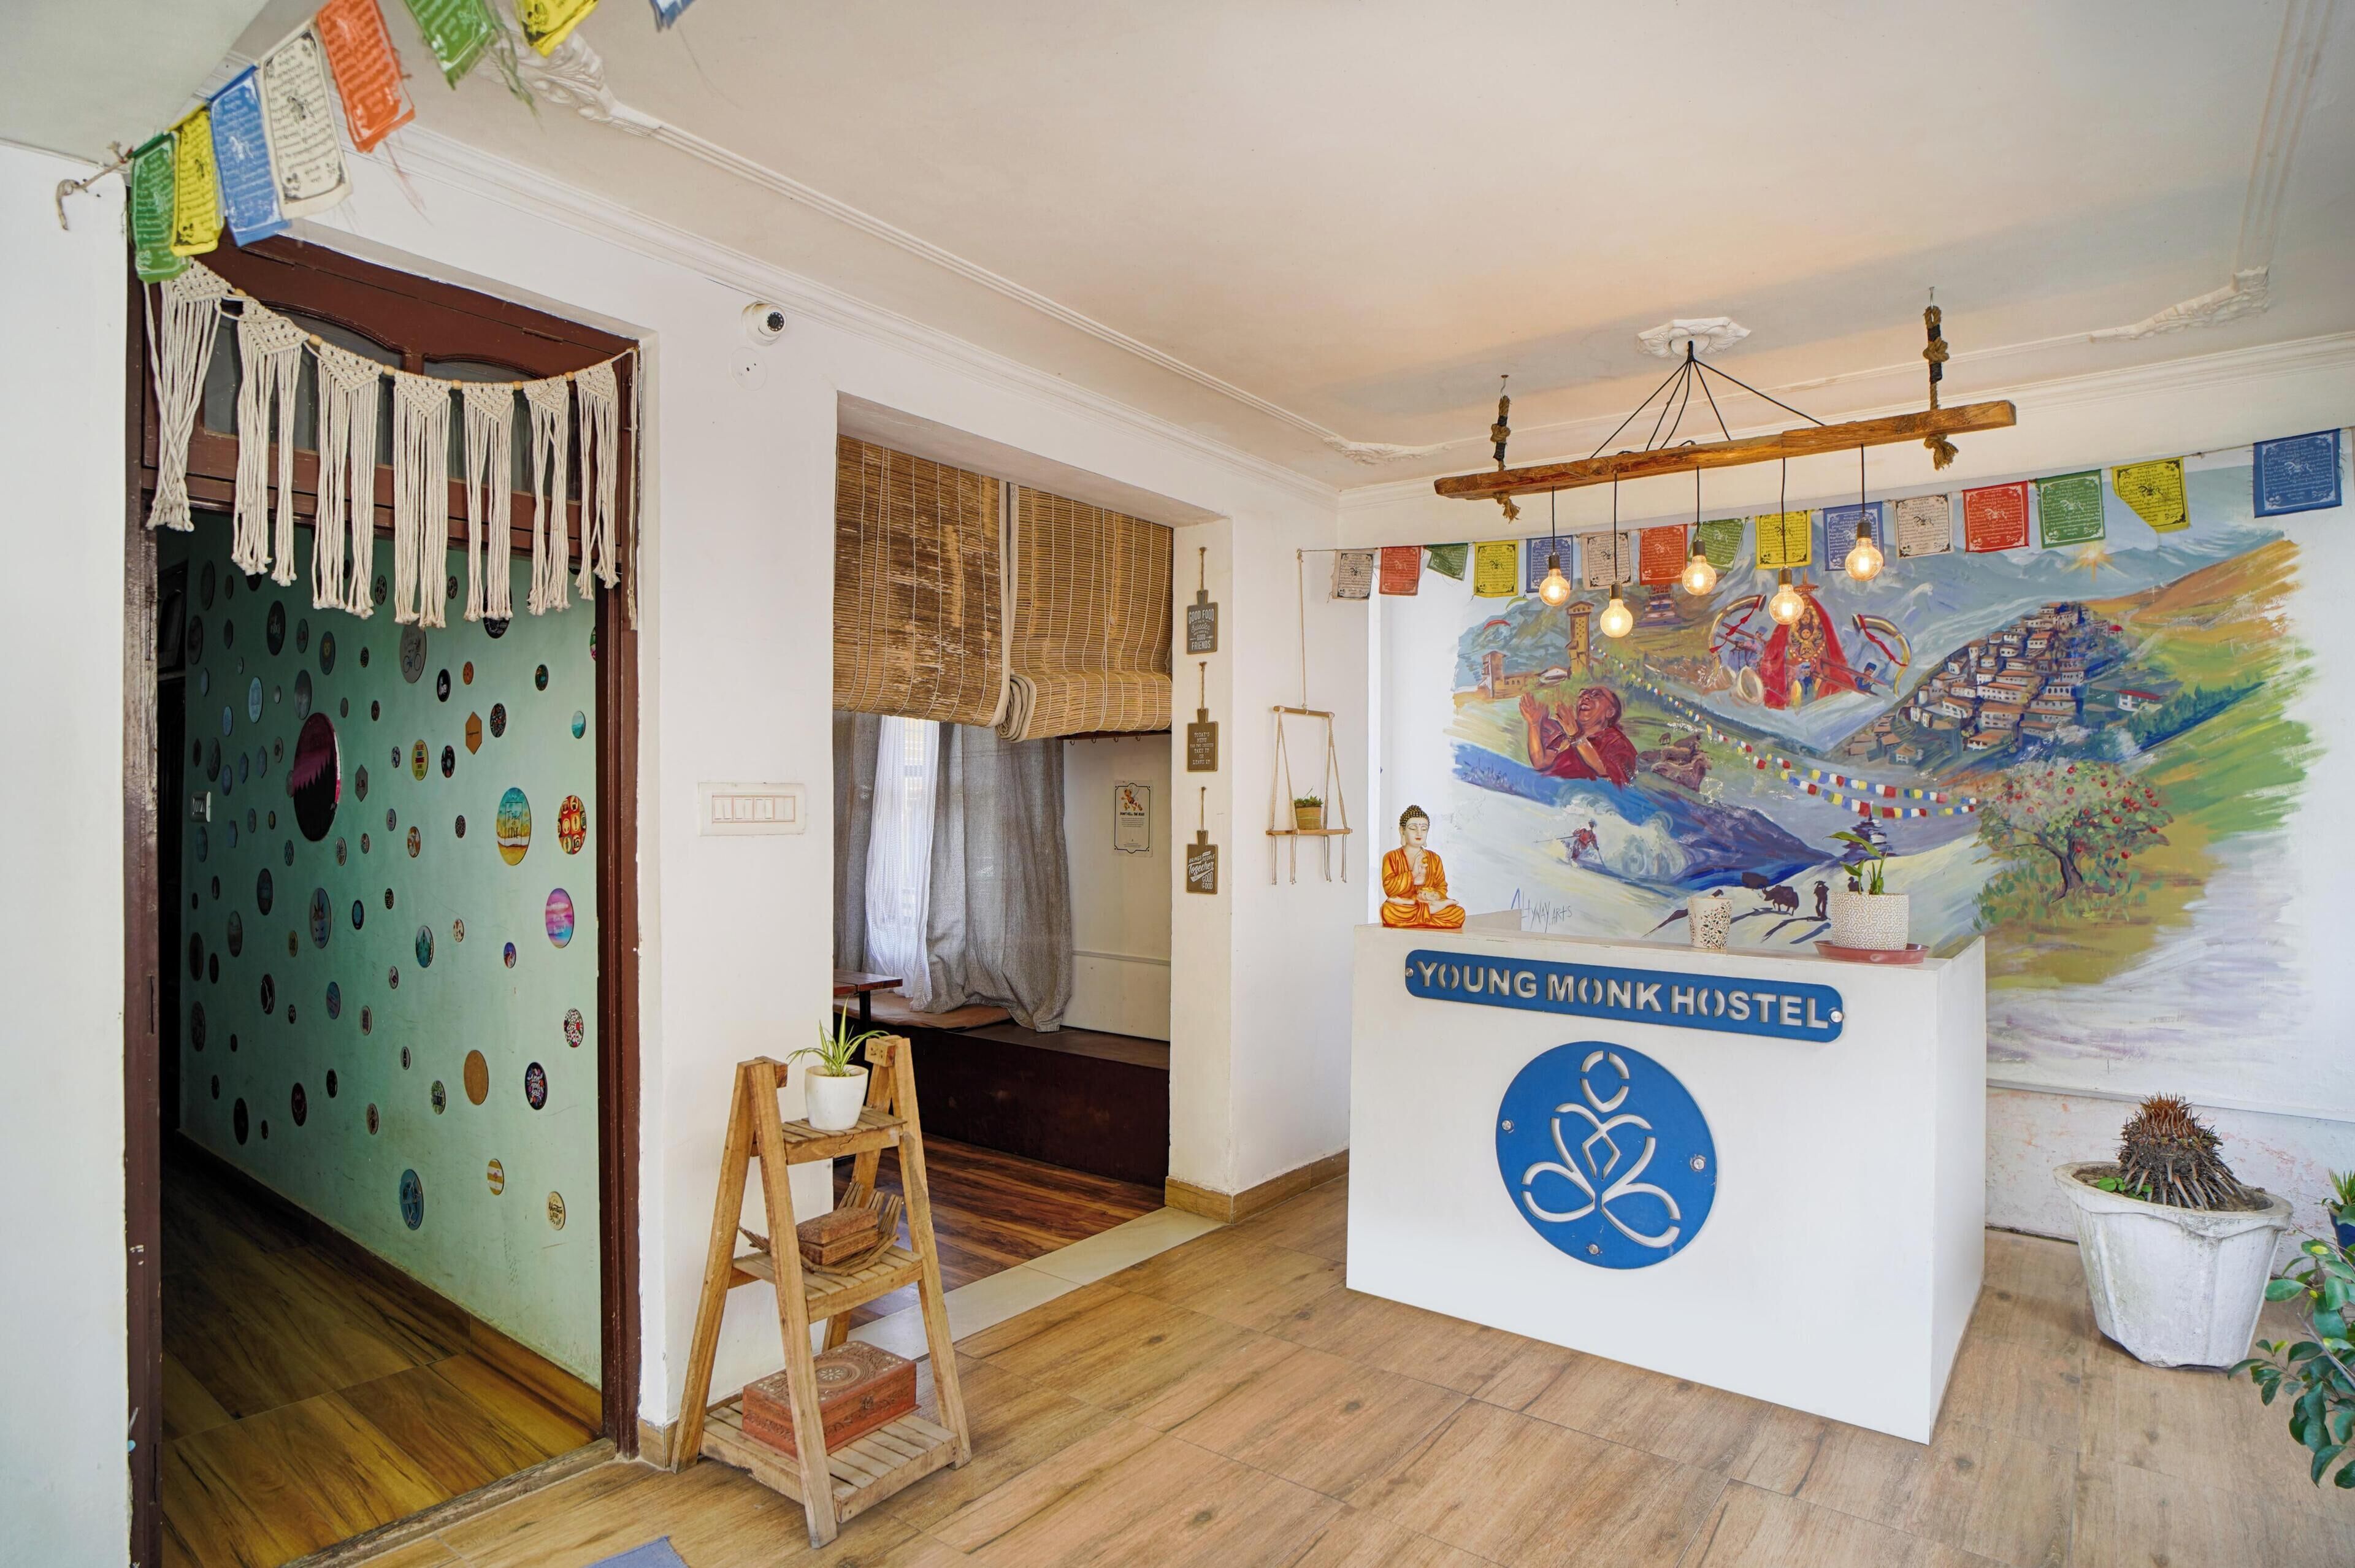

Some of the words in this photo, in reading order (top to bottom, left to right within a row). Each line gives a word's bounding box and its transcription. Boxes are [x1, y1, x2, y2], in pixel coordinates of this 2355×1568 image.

[1189, 610, 1201, 624] GOOD
[1202, 608, 1214, 621] FOOD
[1192, 640, 1211, 650] FRIENDS
[1202, 871, 1213, 882] GOOD
[1416, 960, 1536, 998] YOUNG
[1547, 973, 1663, 1012] MONK
[1670, 984, 1828, 1029] HOSTEL
